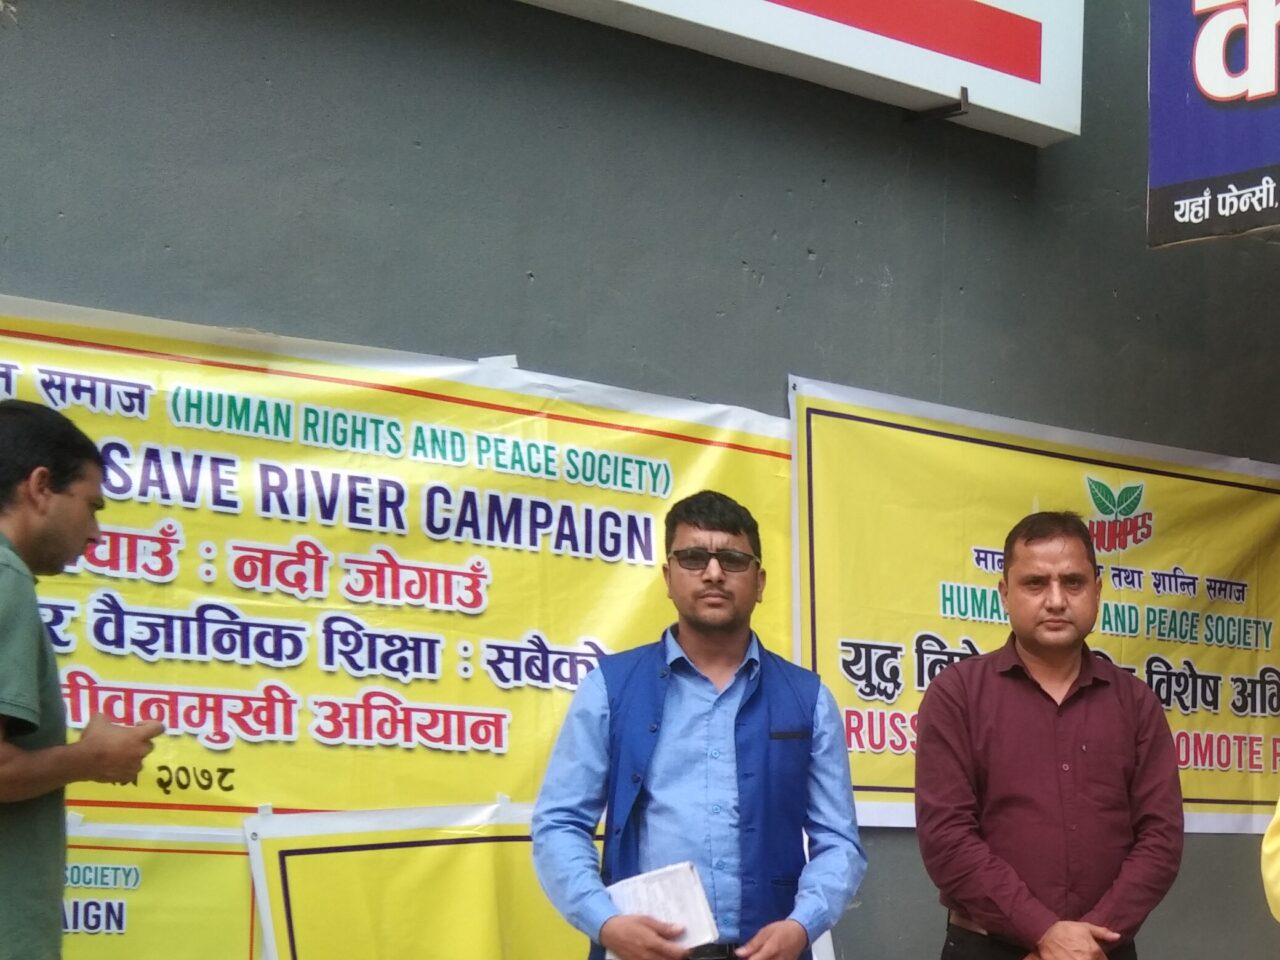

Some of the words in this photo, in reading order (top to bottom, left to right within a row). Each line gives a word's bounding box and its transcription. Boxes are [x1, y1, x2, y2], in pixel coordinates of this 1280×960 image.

[1174, 187, 1210, 224] यहाँ
[36, 368, 153, 416] समाज
[172, 386, 291, 438] (HUMAN
[303, 409, 401, 455] RIGHTS
[413, 426, 465, 462] AND
[477, 435, 557, 477] PEACE
[566, 448, 671, 495] SOCIETY)
[101, 442, 239, 509] SAVE
[259, 463, 406, 530] RIVER
[425, 486, 654, 561] CAMPAIGN
[232, 540, 328, 594] नदी
[345, 549, 487, 608] जोगाउँ
[1110, 567, 1142, 590] तथा
[1152, 566, 1198, 596] शान्ति
[1206, 577, 1247, 602] समाज
[93, 593, 305, 661] वैज्ञानिक
[322, 616, 440, 677] शिक्षा
[941, 583, 1009, 622] HUMA
[1101, 602, 1139, 634] AND
[1146, 607, 1200, 641] PEACE
[1204, 614, 1272, 648] SOCIETY
[313, 691, 507, 748] अभियान
